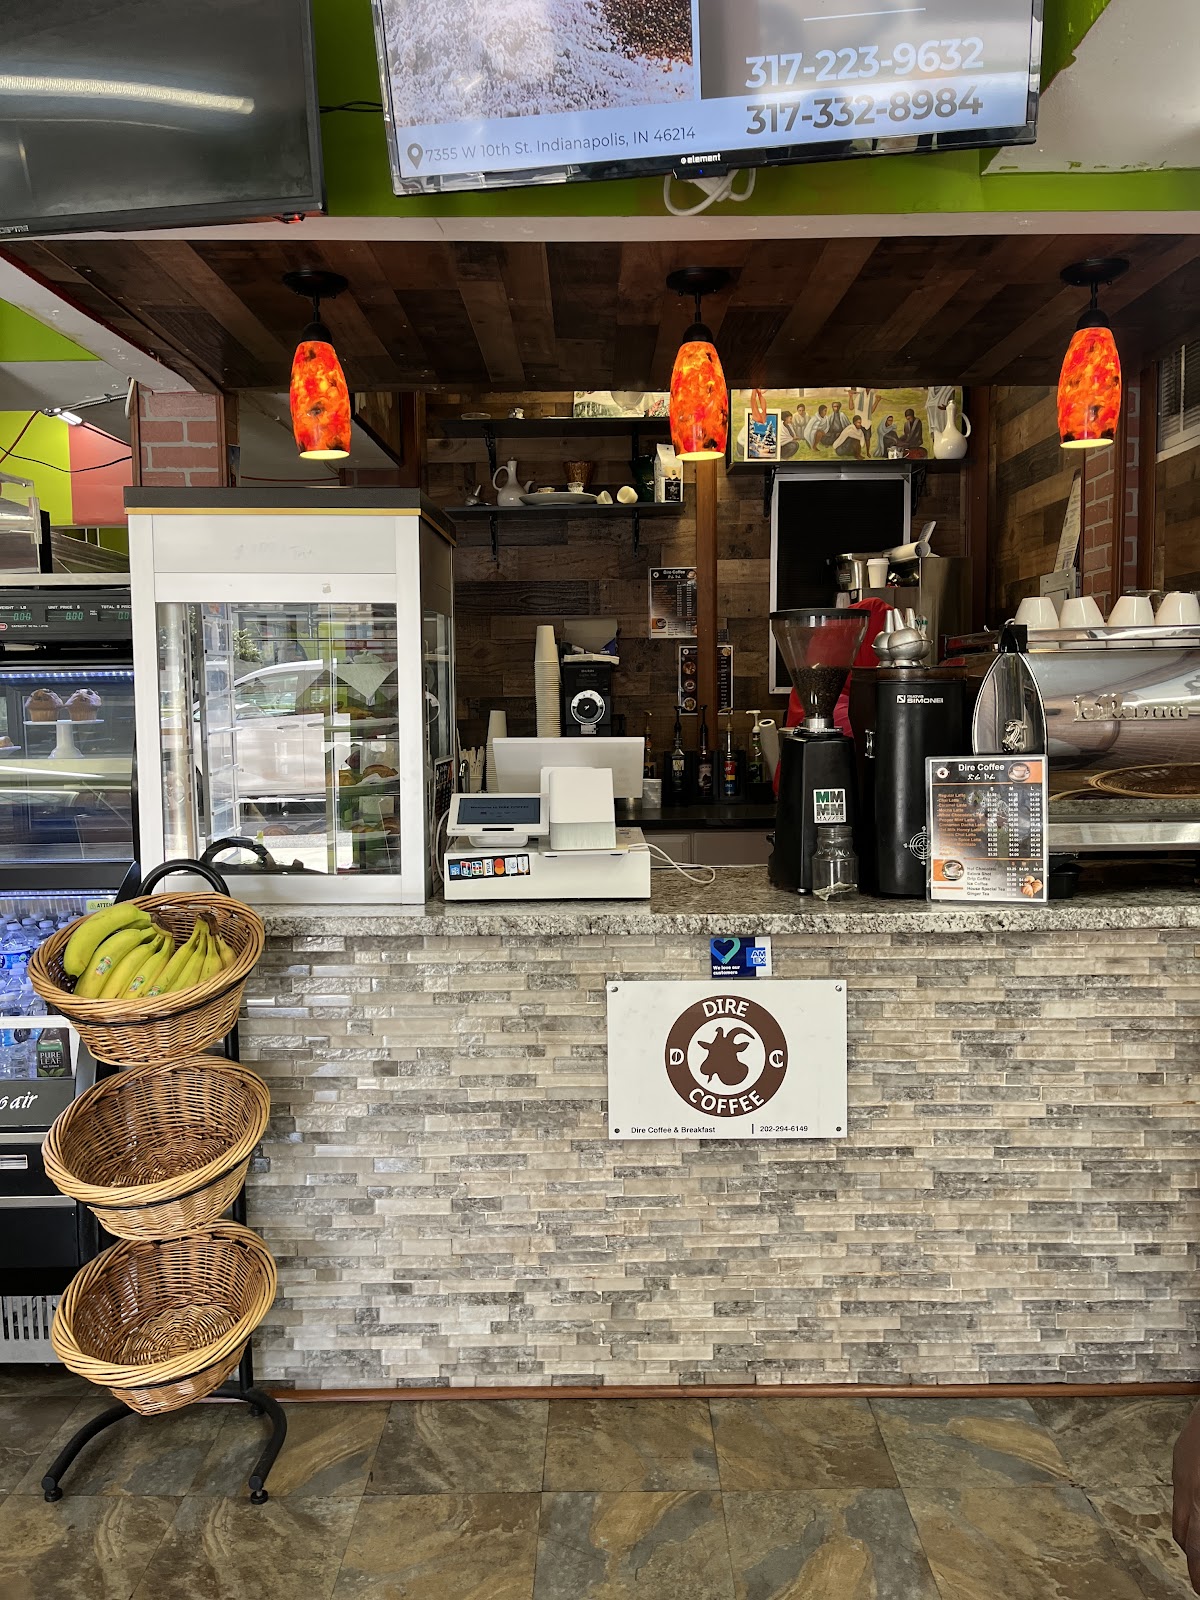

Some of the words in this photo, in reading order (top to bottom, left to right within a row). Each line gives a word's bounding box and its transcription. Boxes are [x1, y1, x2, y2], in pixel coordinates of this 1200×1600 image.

[745, 37, 984, 89] 317-223-9632
[746, 85, 984, 135] 317-332-8984
[425, 147, 458, 162] 7355
[461, 146, 477, 158] W
[481, 143, 511, 158] 10th
[514, 142, 533, 155] St.
[537, 133, 629, 152] Indianapolis,
[633, 130, 649, 144] IN
[653, 126, 696, 142] 46214
[687, 153, 721, 164] element
[958, 764, 976, 772] Dire
[977, 763, 1005, 771] Coffee
[702, 998, 750, 1018] DIRE
[10, 1090, 38, 1110] air
[689, 1088, 764, 1114] COFFEE
